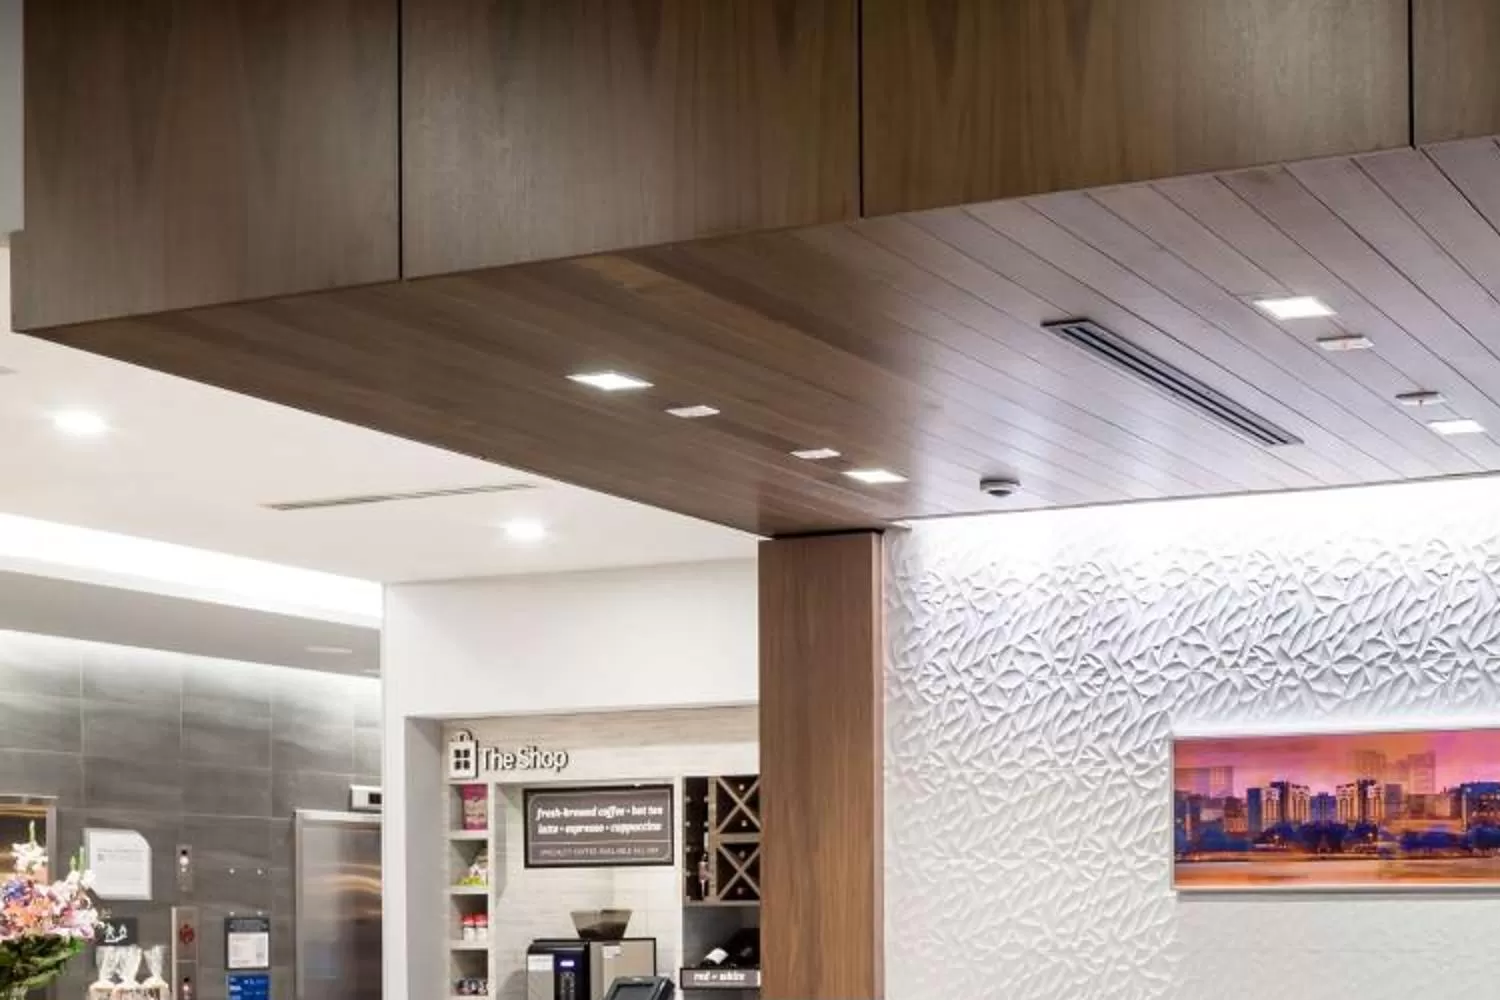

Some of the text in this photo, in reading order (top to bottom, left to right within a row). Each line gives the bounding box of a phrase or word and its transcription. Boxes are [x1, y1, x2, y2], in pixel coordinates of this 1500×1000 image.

[482, 745, 569, 775] The Shop
[598, 804, 625, 819] coffee
[694, 969, 711, 981] red
